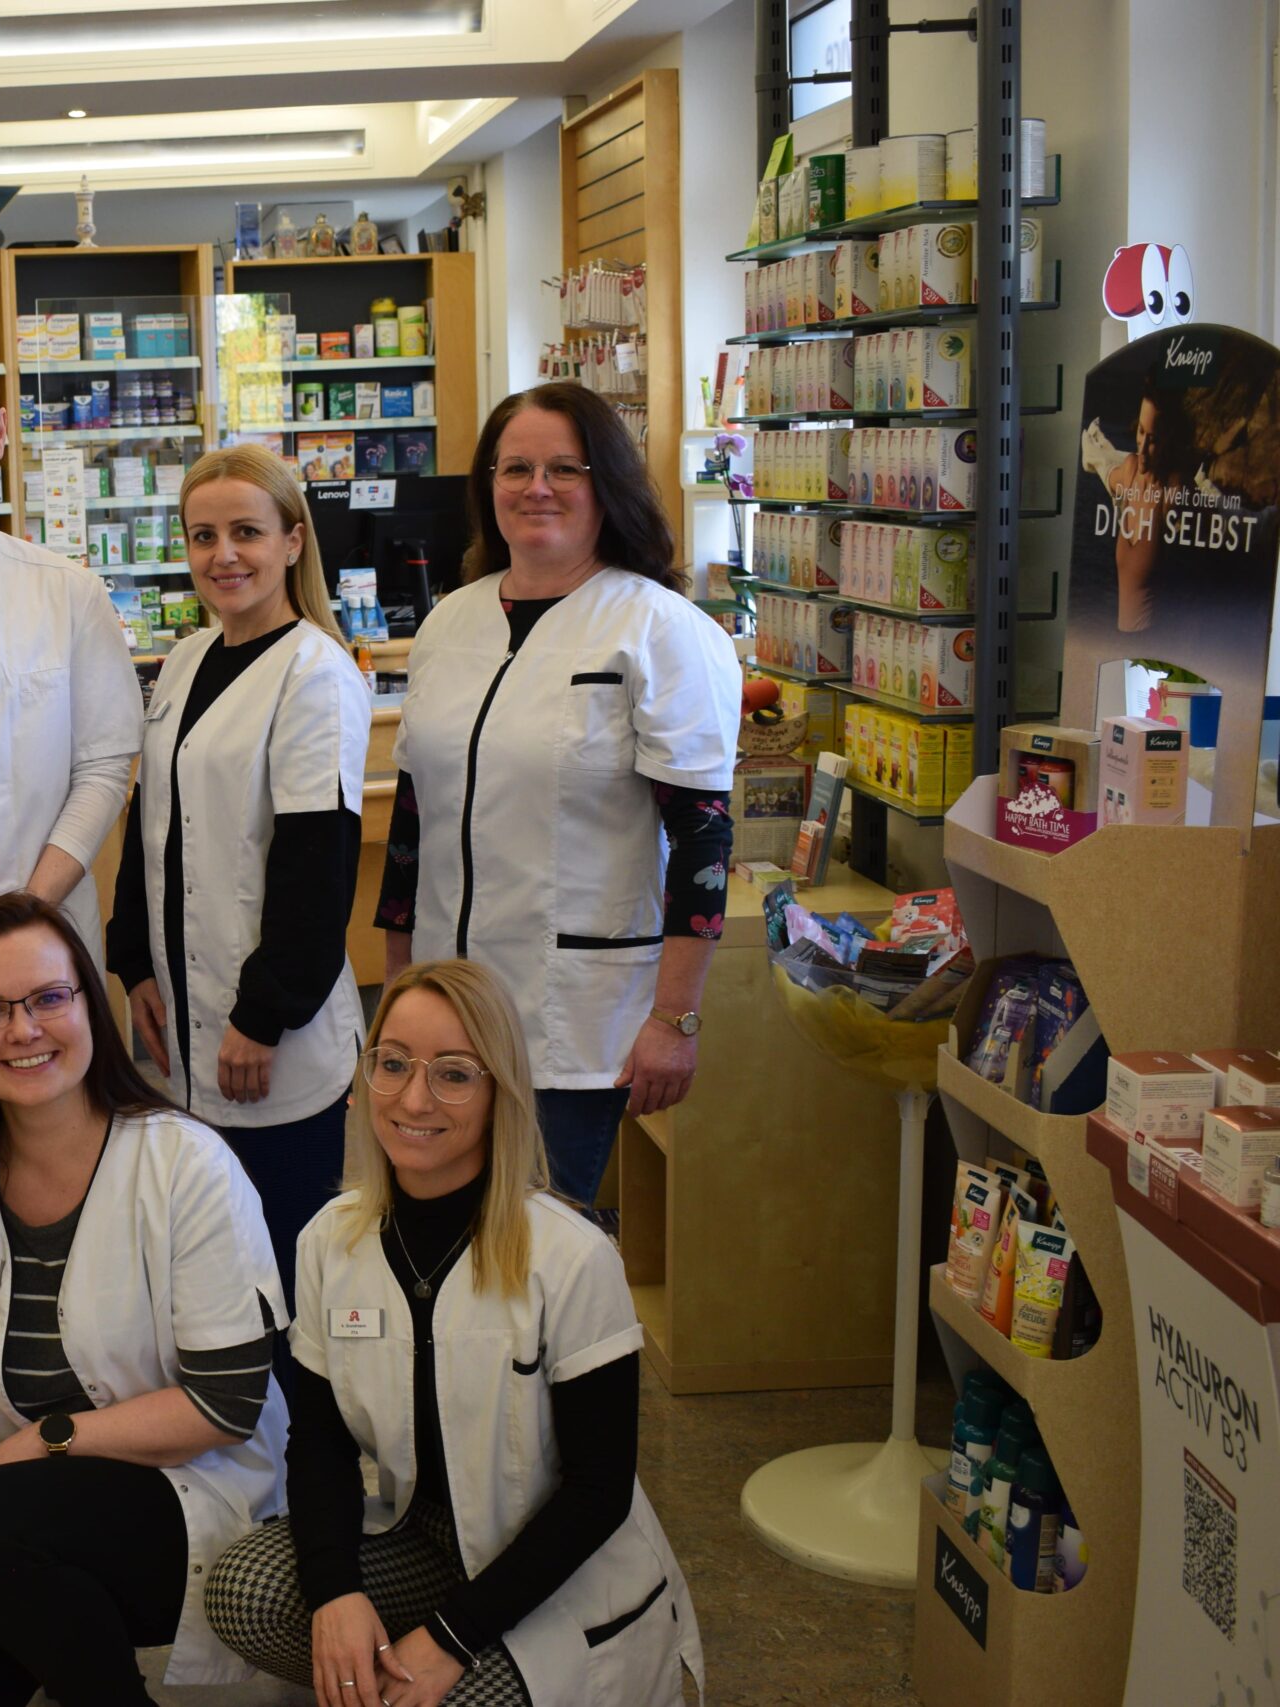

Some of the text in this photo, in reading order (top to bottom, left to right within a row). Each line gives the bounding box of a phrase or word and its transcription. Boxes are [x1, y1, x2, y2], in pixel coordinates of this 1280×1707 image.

[1165, 336, 1213, 375] Kneipp
[317, 490, 350, 500] Lenovo
[1115, 483, 1241, 510] Dreh die Welt öfter um
[1094, 504, 1258, 553] DICH SELBST
[1149, 735, 1179, 748] Kneipp
[1004, 811, 1027, 827] HAPPY
[1028, 814, 1048, 830] BATH
[1048, 821, 1070, 835] TIME
[1035, 1236, 1062, 1251] Kneipp
[1148, 1305, 1260, 1443] HYALURON
[1156, 1354, 1248, 1472] ACTIV B3
[941, 1551, 983, 1624] Kneipp
